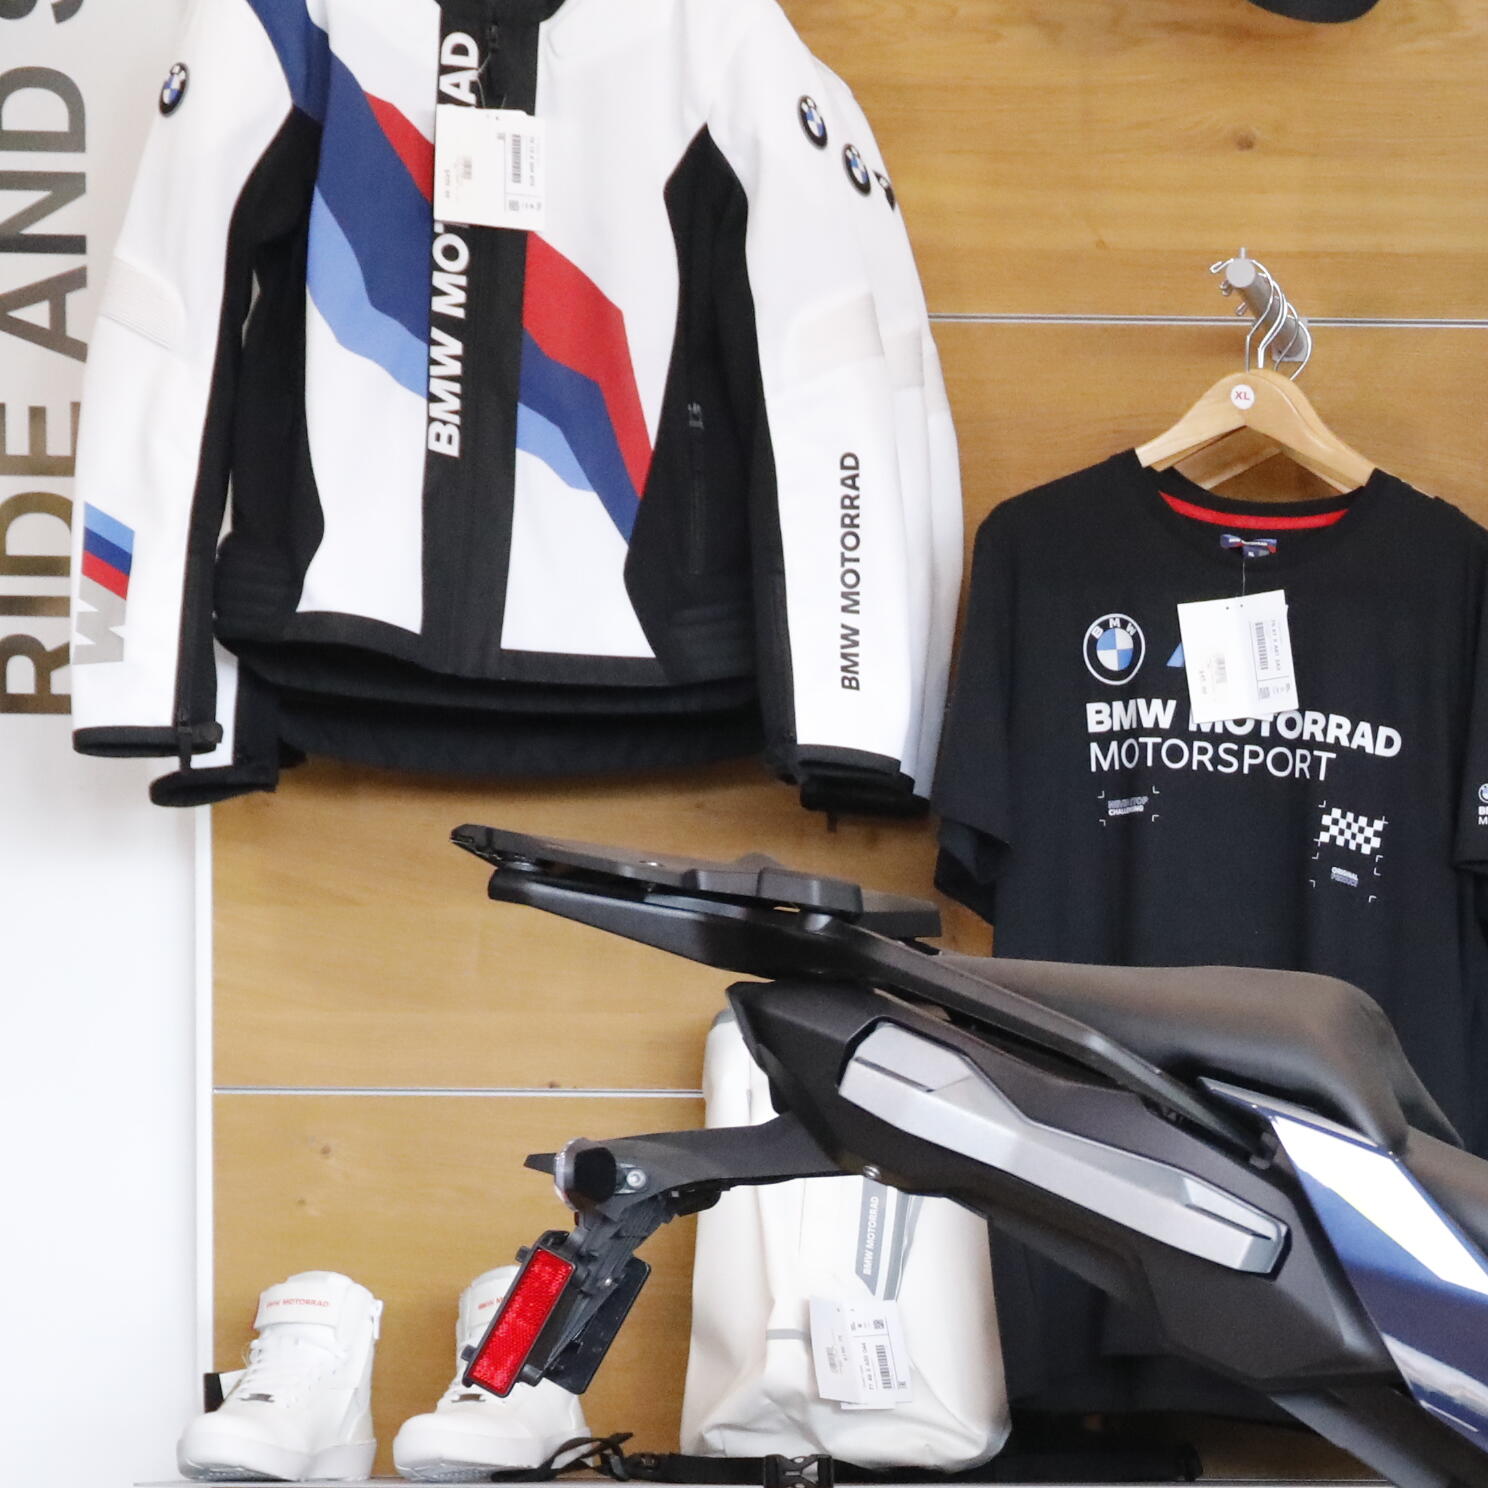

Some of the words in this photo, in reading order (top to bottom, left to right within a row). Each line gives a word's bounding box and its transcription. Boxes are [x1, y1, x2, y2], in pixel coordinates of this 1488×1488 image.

[431, 31, 480, 319] MOAD
[0, 66, 87, 364] AND
[428, 332, 464, 458] BMW
[1235, 391, 1250, 401] XL
[0, 401, 81, 714] RIDE
[839, 451, 861, 615] MOTORRAD
[839, 624, 861, 691] BMW
[1090, 617, 1137, 640] BMW
[1085, 698, 1177, 733] BMW
[1089, 737, 1337, 781] MOTORSPORT
[864, 1195, 880, 1251] MOTORRAD
